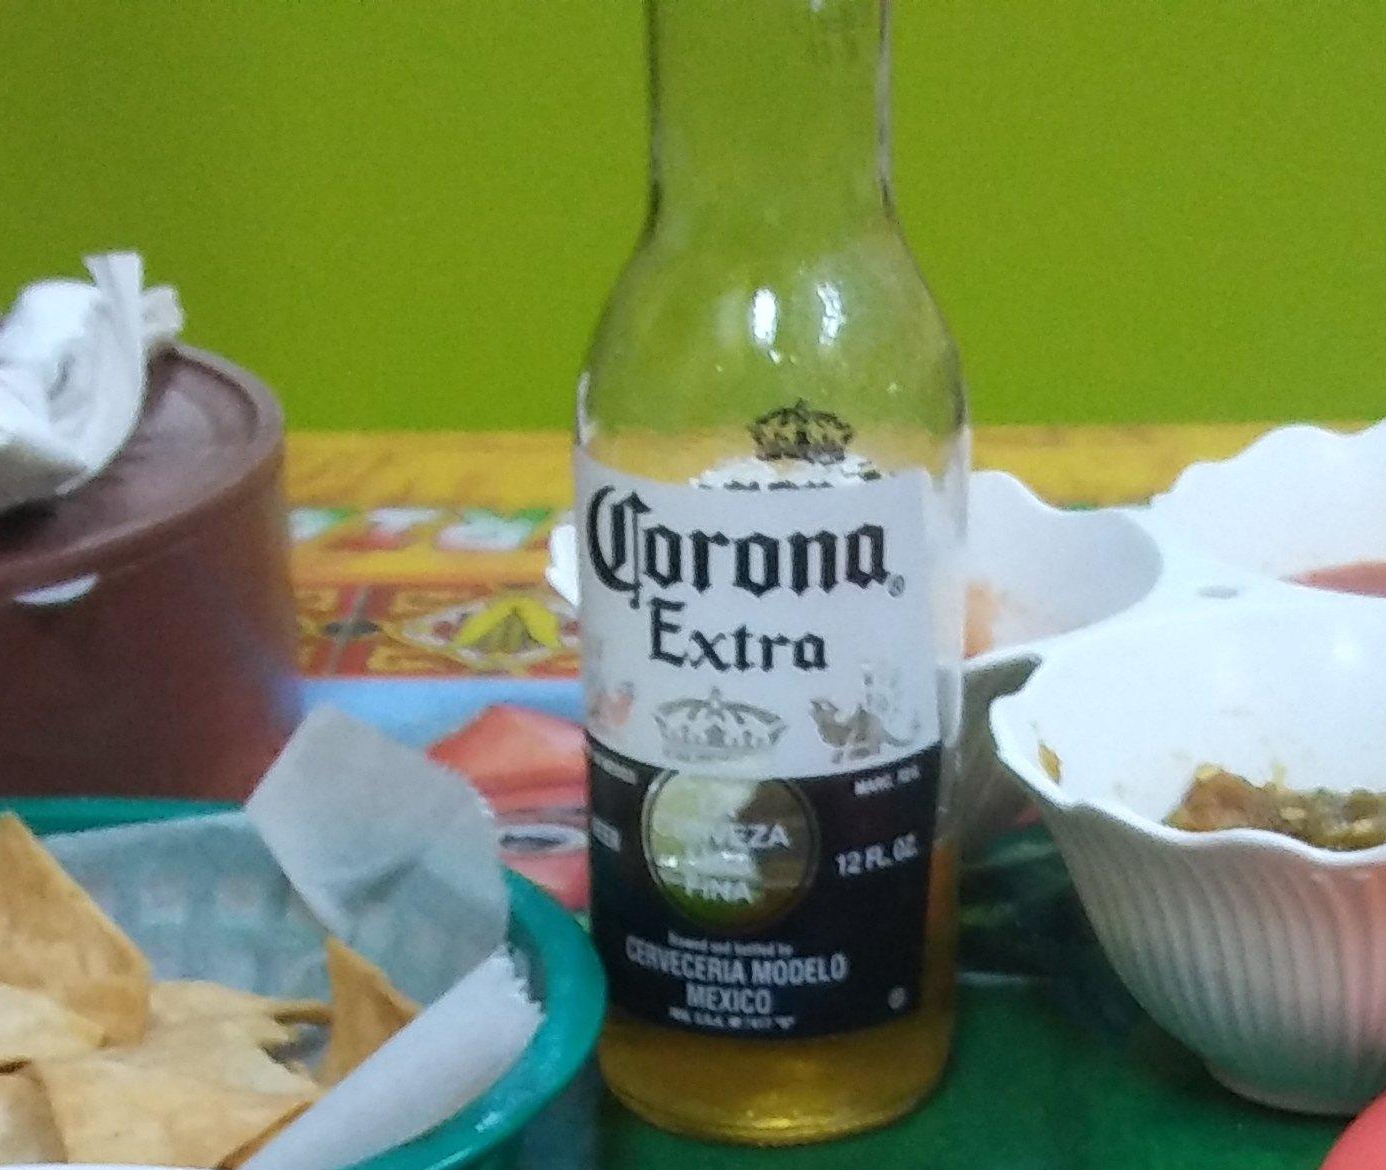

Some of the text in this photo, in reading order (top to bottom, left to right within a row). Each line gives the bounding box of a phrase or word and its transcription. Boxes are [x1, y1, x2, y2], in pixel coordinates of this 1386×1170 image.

[588, 486, 888, 608] Corona
[646, 598, 829, 672] Extra
[625, 935, 849, 986] CERVECERIA MODELO
